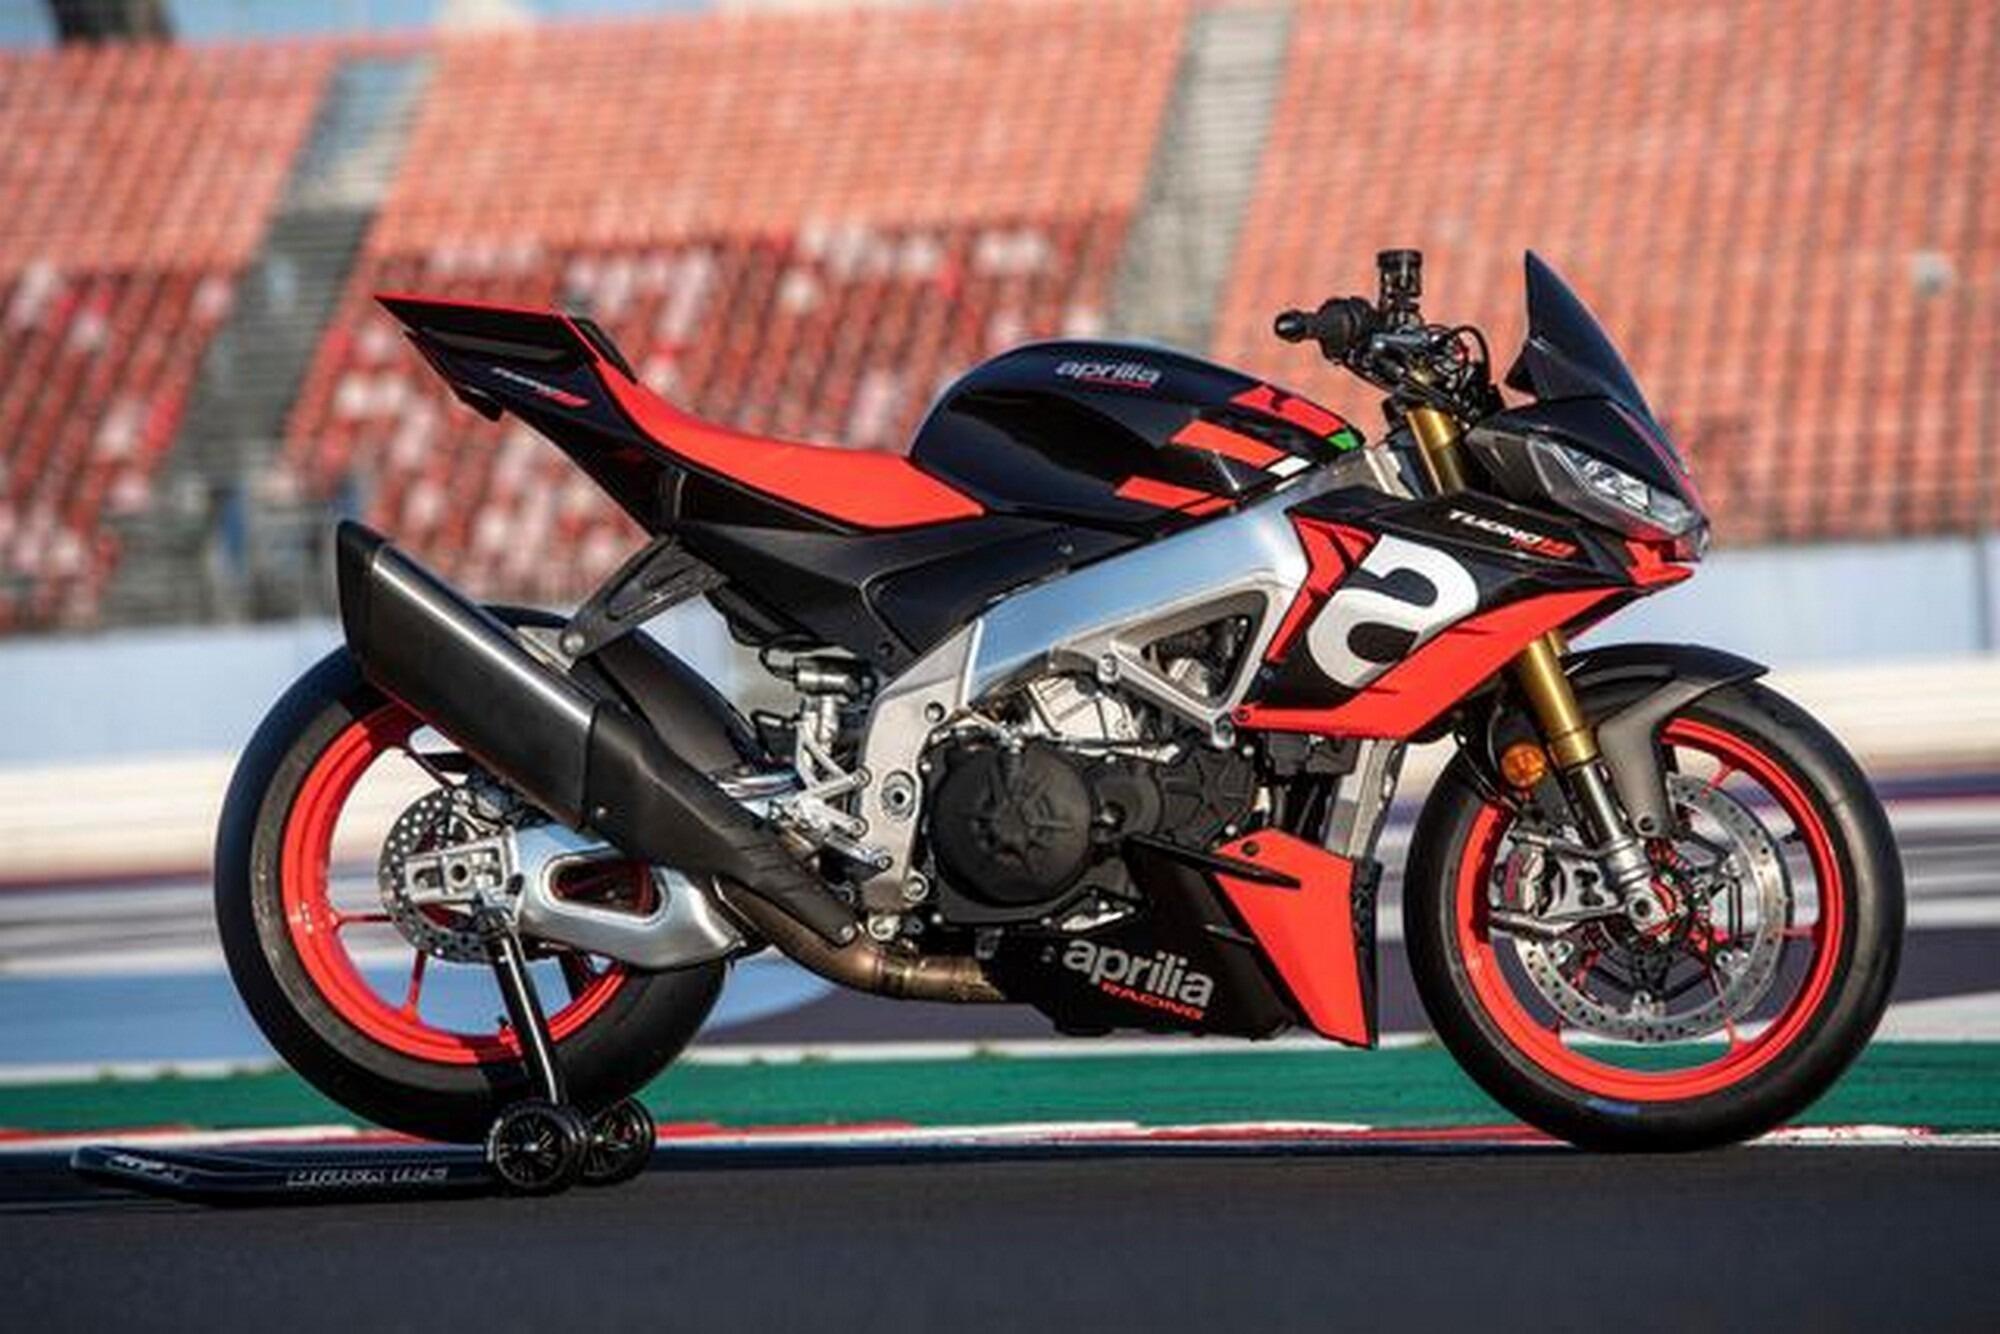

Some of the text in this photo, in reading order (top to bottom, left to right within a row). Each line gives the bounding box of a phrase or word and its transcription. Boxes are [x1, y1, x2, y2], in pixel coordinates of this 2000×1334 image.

[1055, 361, 1161, 384] aprilia
[1062, 939, 1214, 1007] aprilia
[1101, 981, 1205, 1021] RACING
